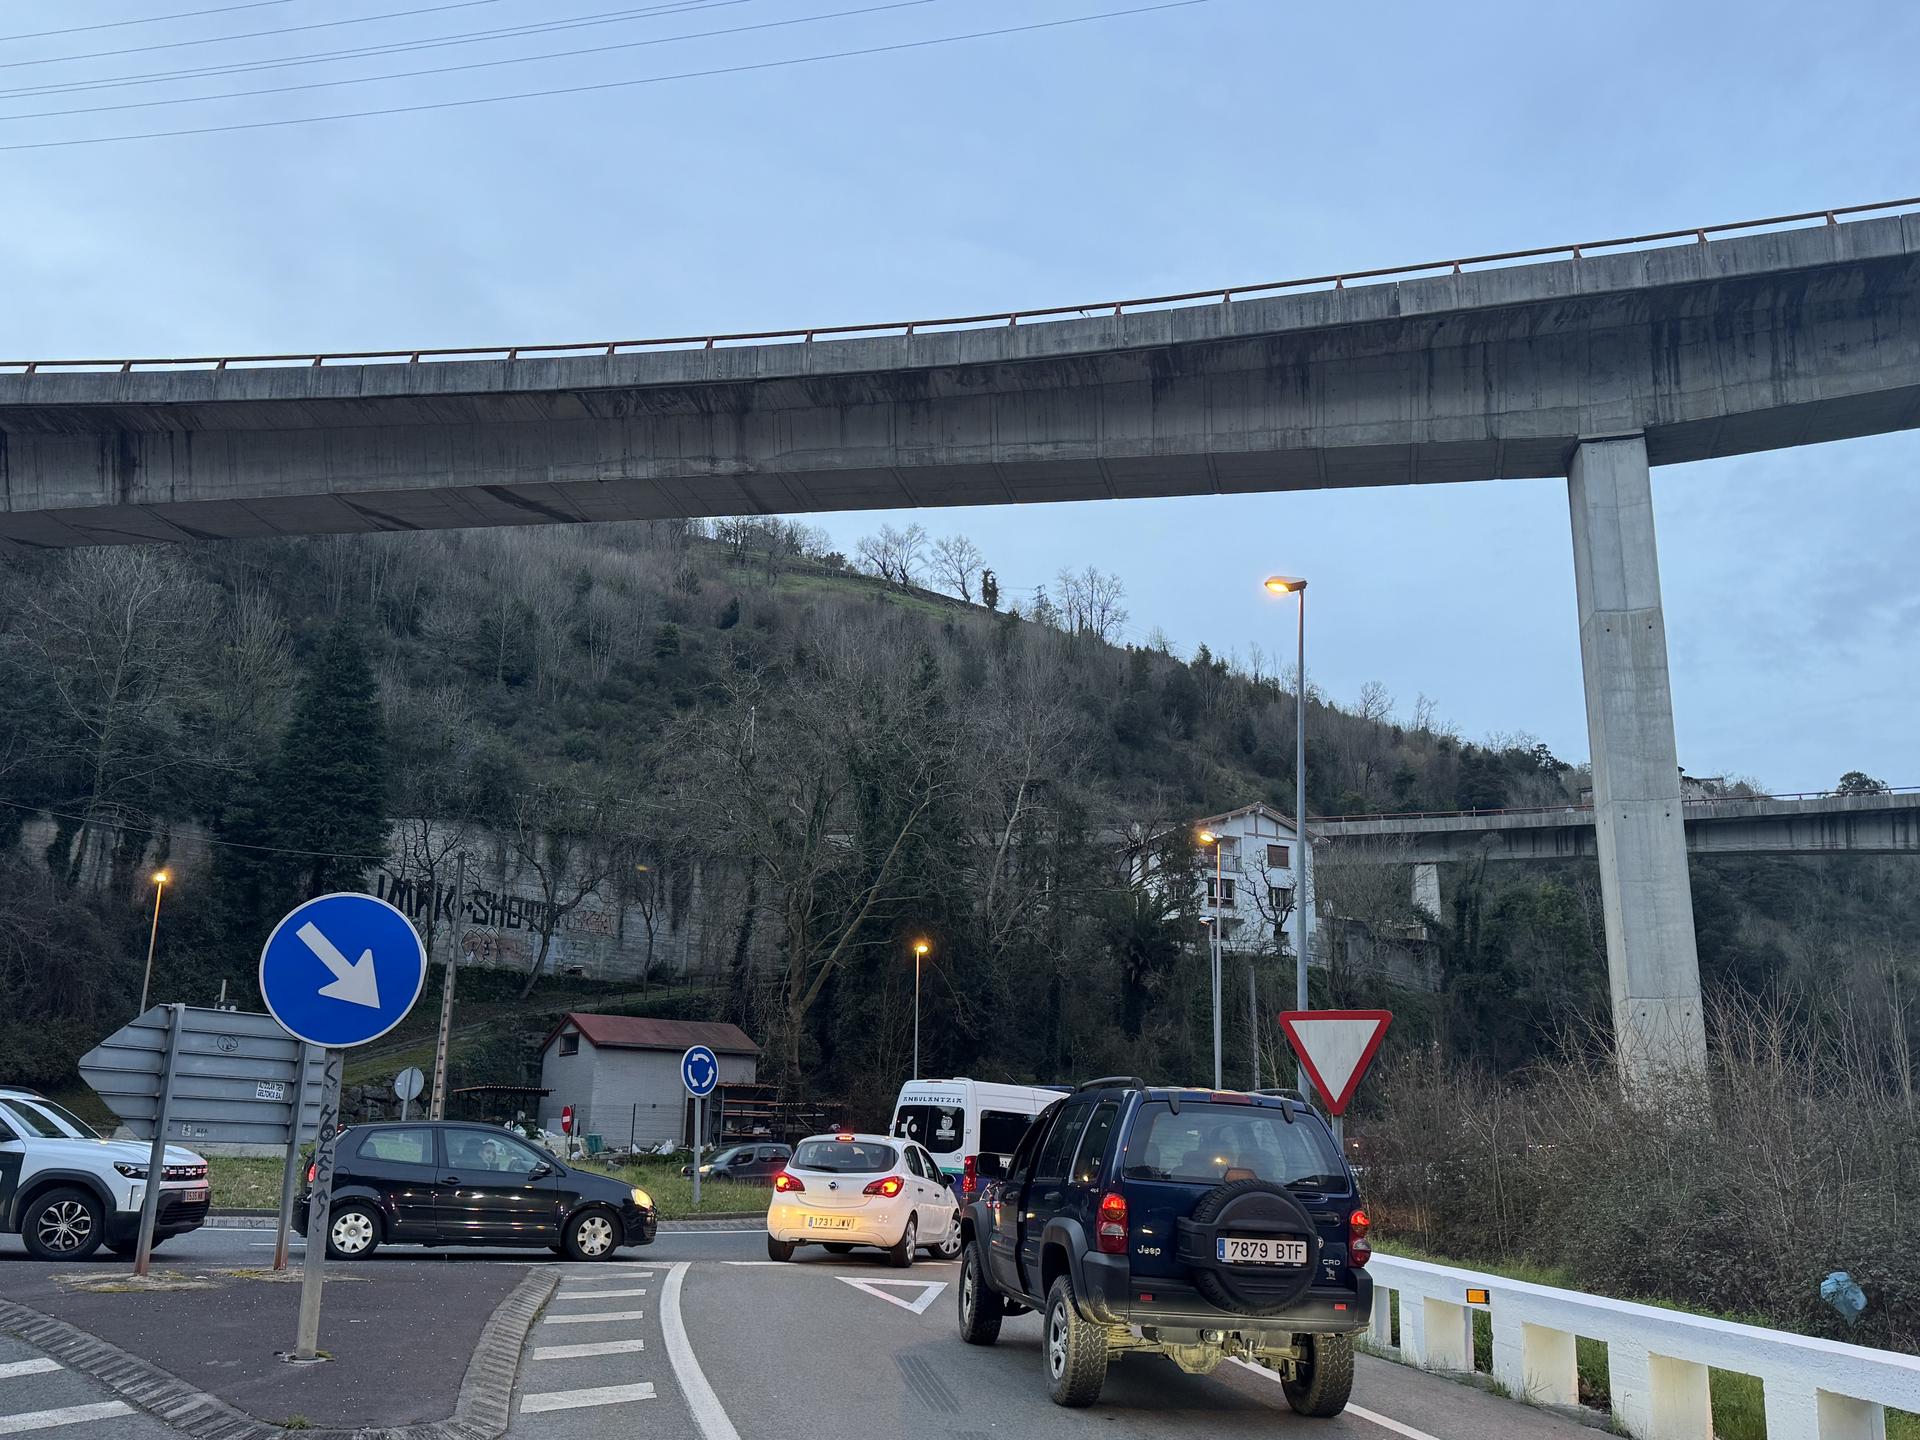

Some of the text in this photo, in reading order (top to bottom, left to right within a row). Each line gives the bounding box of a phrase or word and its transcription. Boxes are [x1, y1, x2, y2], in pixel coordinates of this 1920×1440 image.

[815, 1217, 851, 1227] 1731 JWV
[1137, 1245, 1161, 1256] Jeep
[1230, 1241, 1304, 1260] 7879 BTF
